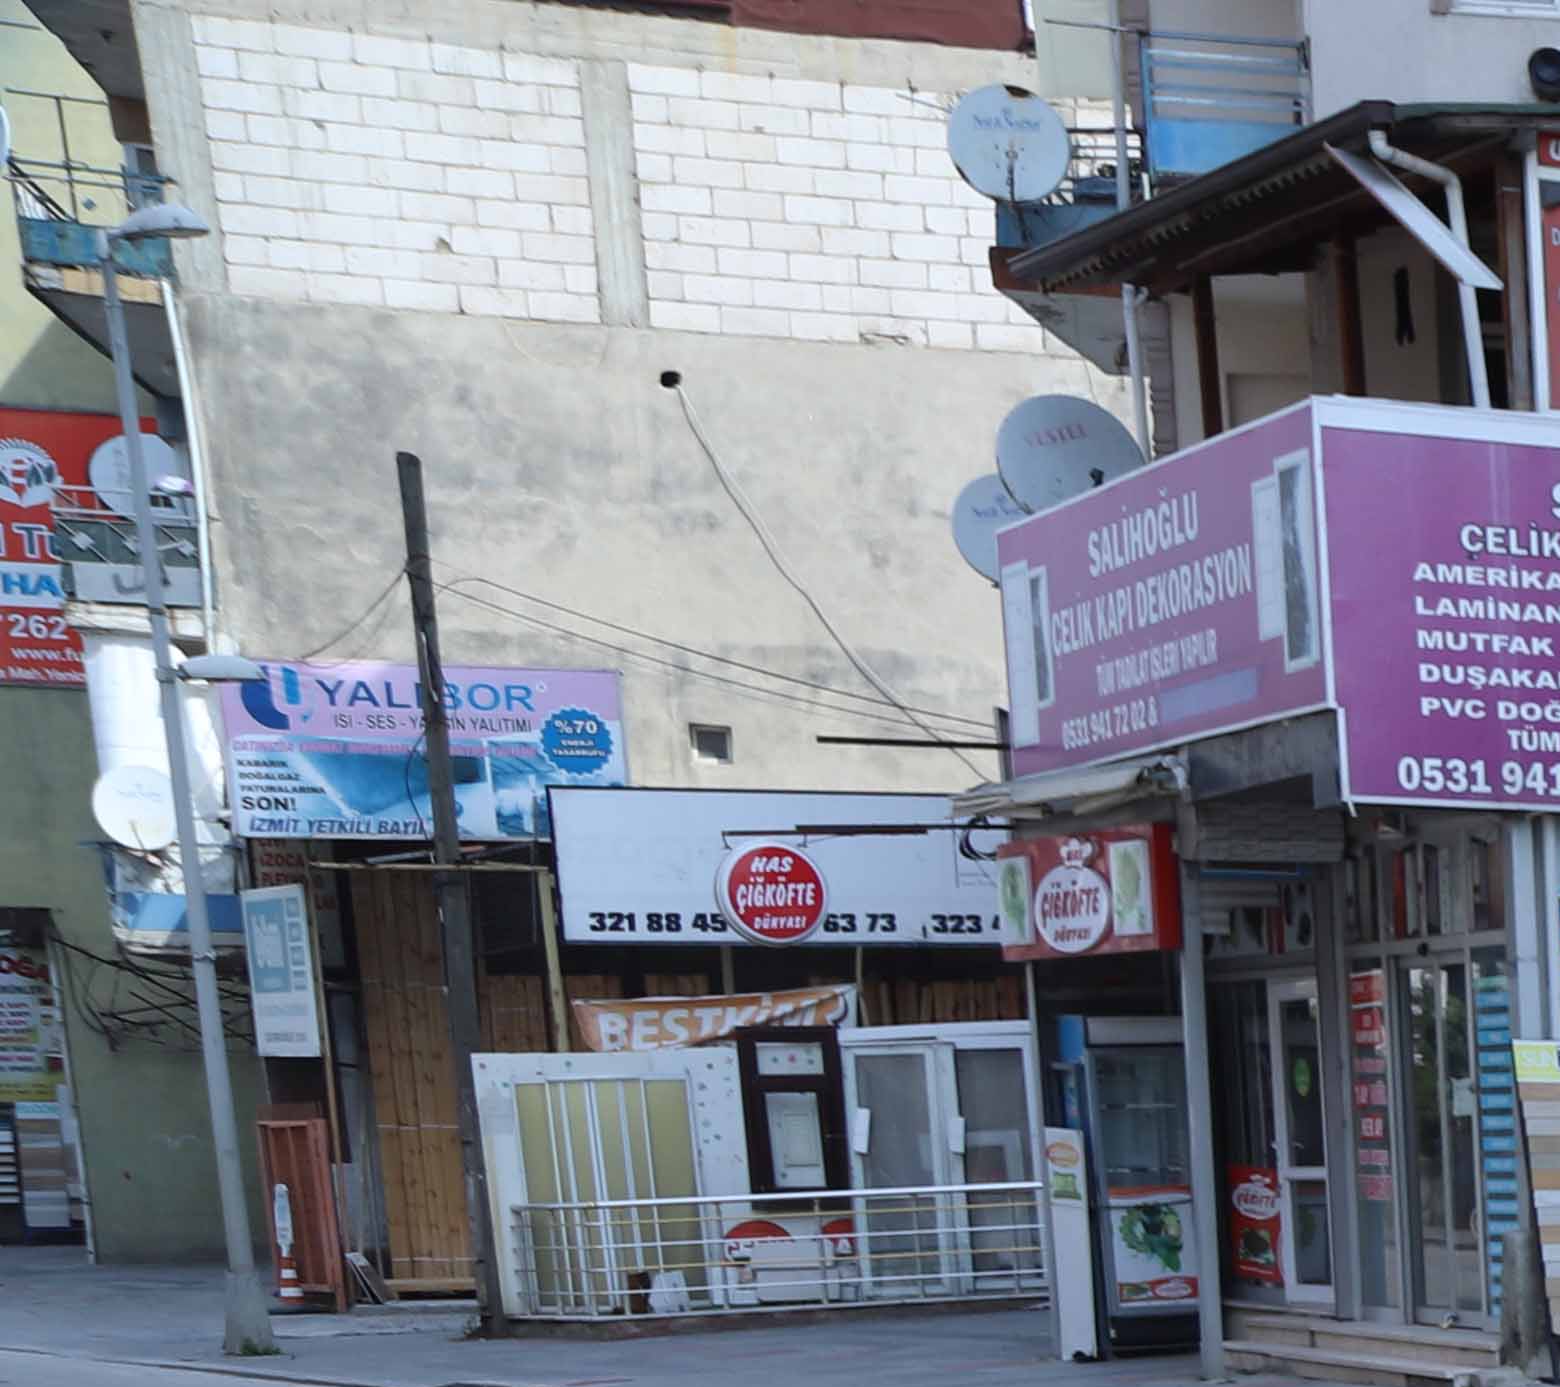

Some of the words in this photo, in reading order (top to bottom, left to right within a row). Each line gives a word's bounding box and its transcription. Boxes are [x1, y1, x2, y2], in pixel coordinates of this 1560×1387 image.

[1088, 487, 1199, 578] SALİHOĞLU
[1052, 592, 1095, 669] ÇELİK
[1095, 586, 1134, 642] KAPI
[1135, 543, 1252, 628] DEKORASYON
[8, 613, 70, 641] 262
[1416, 629, 1554, 657] MUTFAK
[1420, 697, 1488, 720] PVC
[365, 713, 397, 731] SES
[469, 717, 533, 734] YALITIMI
[553, 719, 598, 735] %70
[1061, 715, 1091, 751] 0531
[1089, 708, 1113, 743] 941
[1112, 703, 1130, 737] 72
[1129, 698, 1147, 731] 02
[1397, 756, 1493, 794] 0531
[240, 796, 298, 812] SON!
[249, 815, 303, 833] İZMİT
[750, 855, 795, 873] HAS
[735, 876, 816, 915] ÇİĞKÖFTE
[588, 912, 637, 933] 321
[646, 913, 683, 933] 88
[691, 913, 728, 933] 45
[822, 913, 857, 933] 63
[866, 914, 897, 933] 73
[931, 914, 983, 935] 323
[754, 912, 807, 930] DÜNYASI
